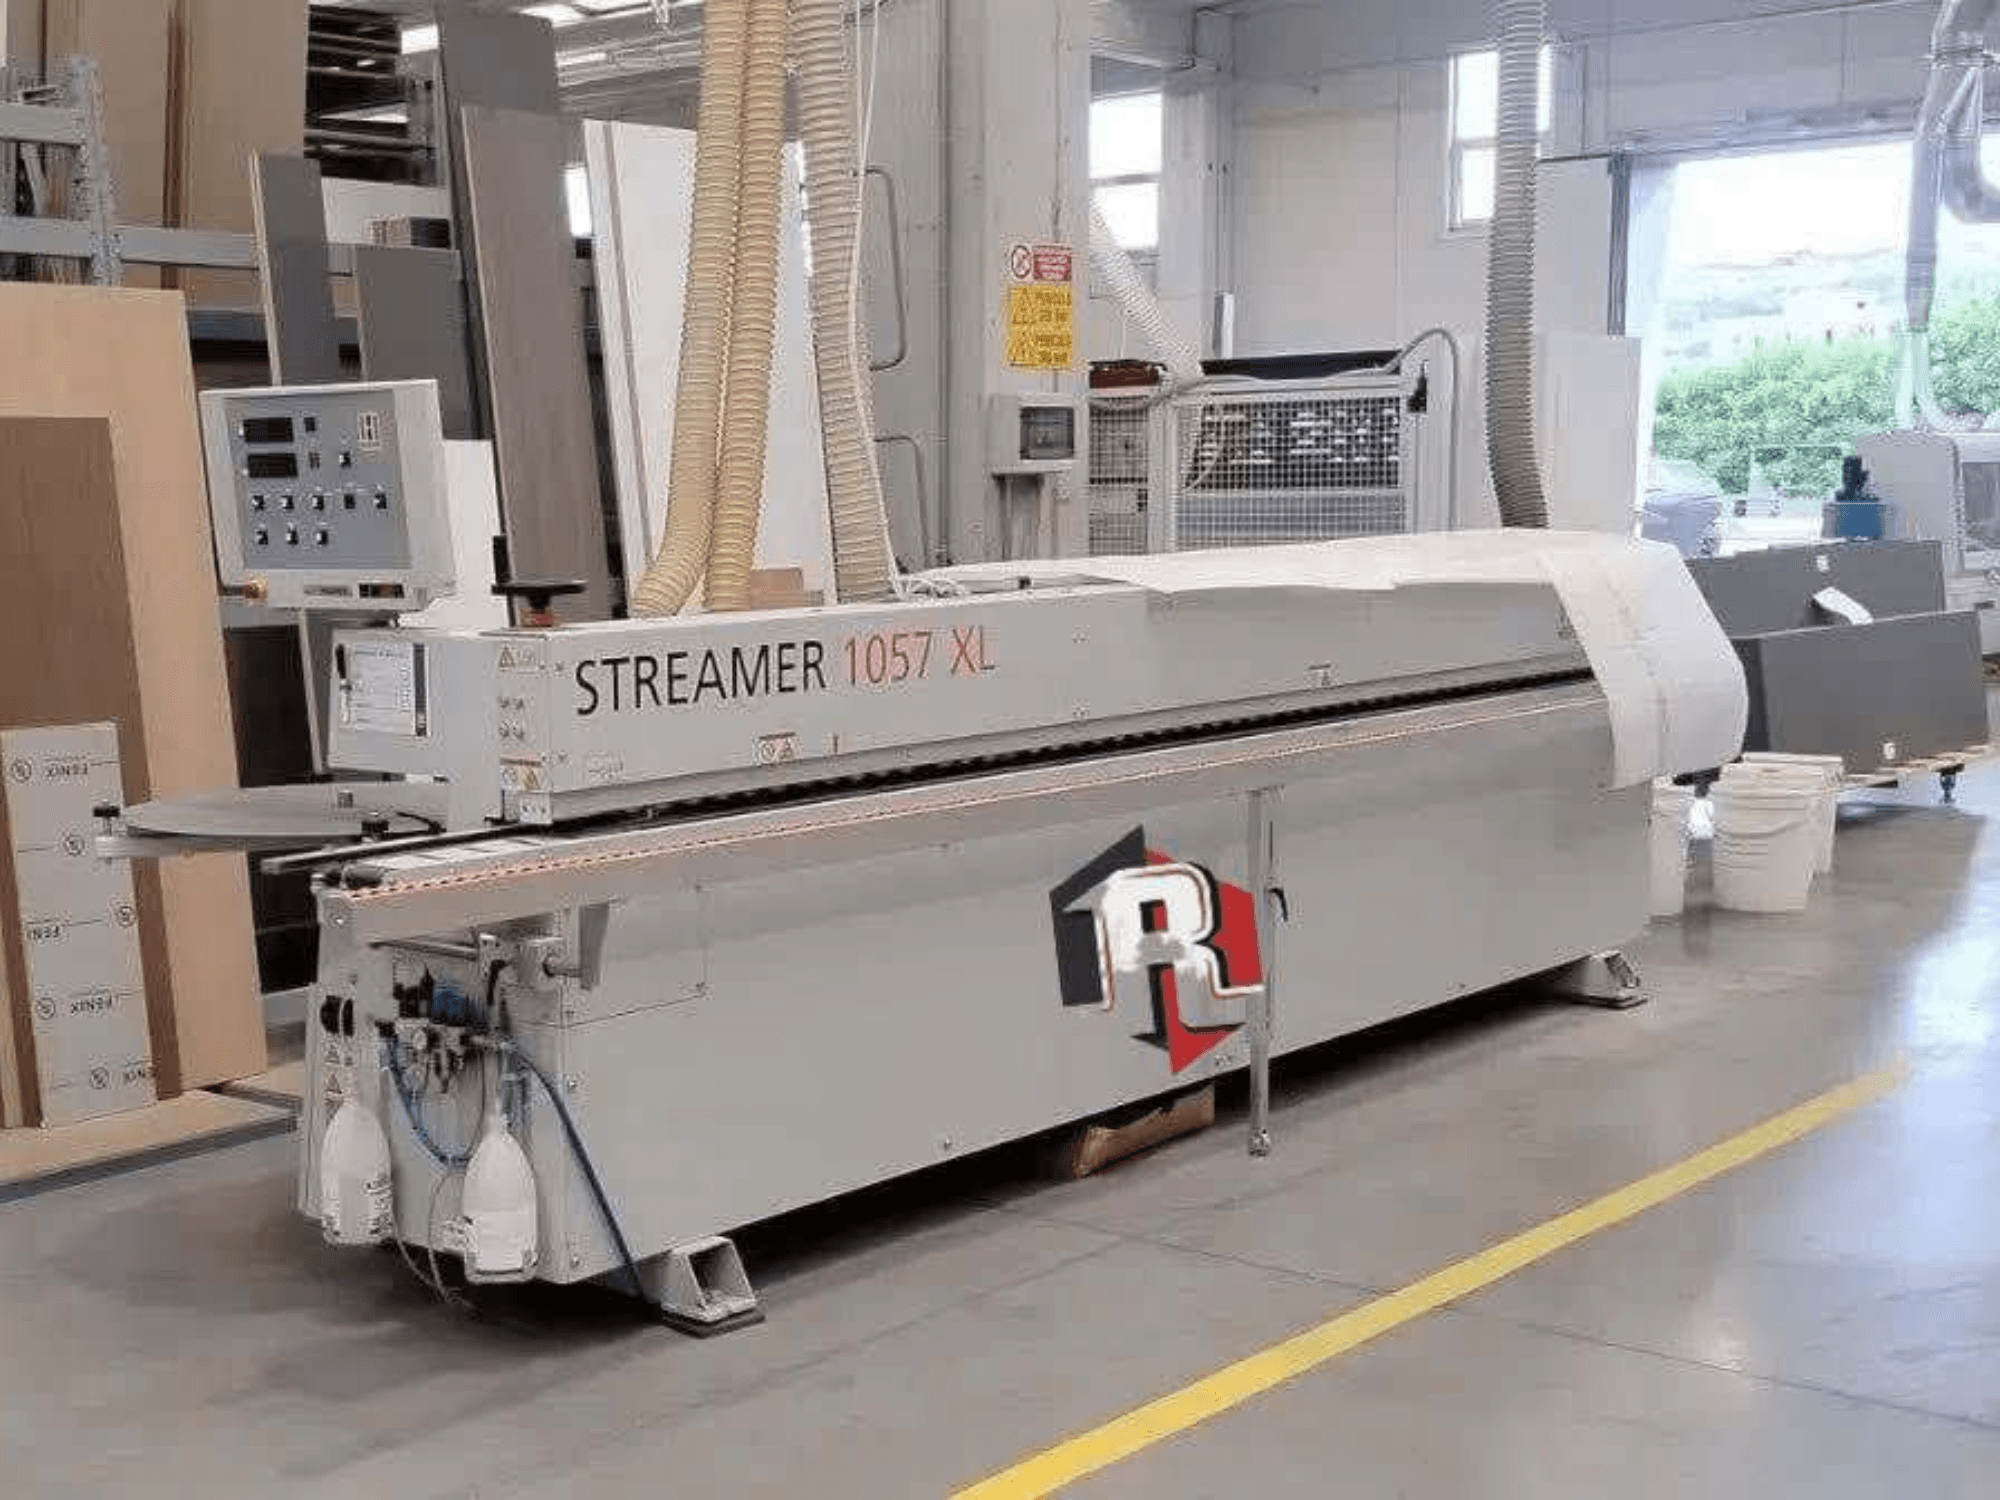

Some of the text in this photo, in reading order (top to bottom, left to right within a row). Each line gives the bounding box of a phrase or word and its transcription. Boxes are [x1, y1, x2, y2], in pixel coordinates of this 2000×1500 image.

[574, 625, 996, 716] STREAMER 1057 XL
[46, 761, 89, 777] FENIX
[70, 996, 115, 1014] FENIX
